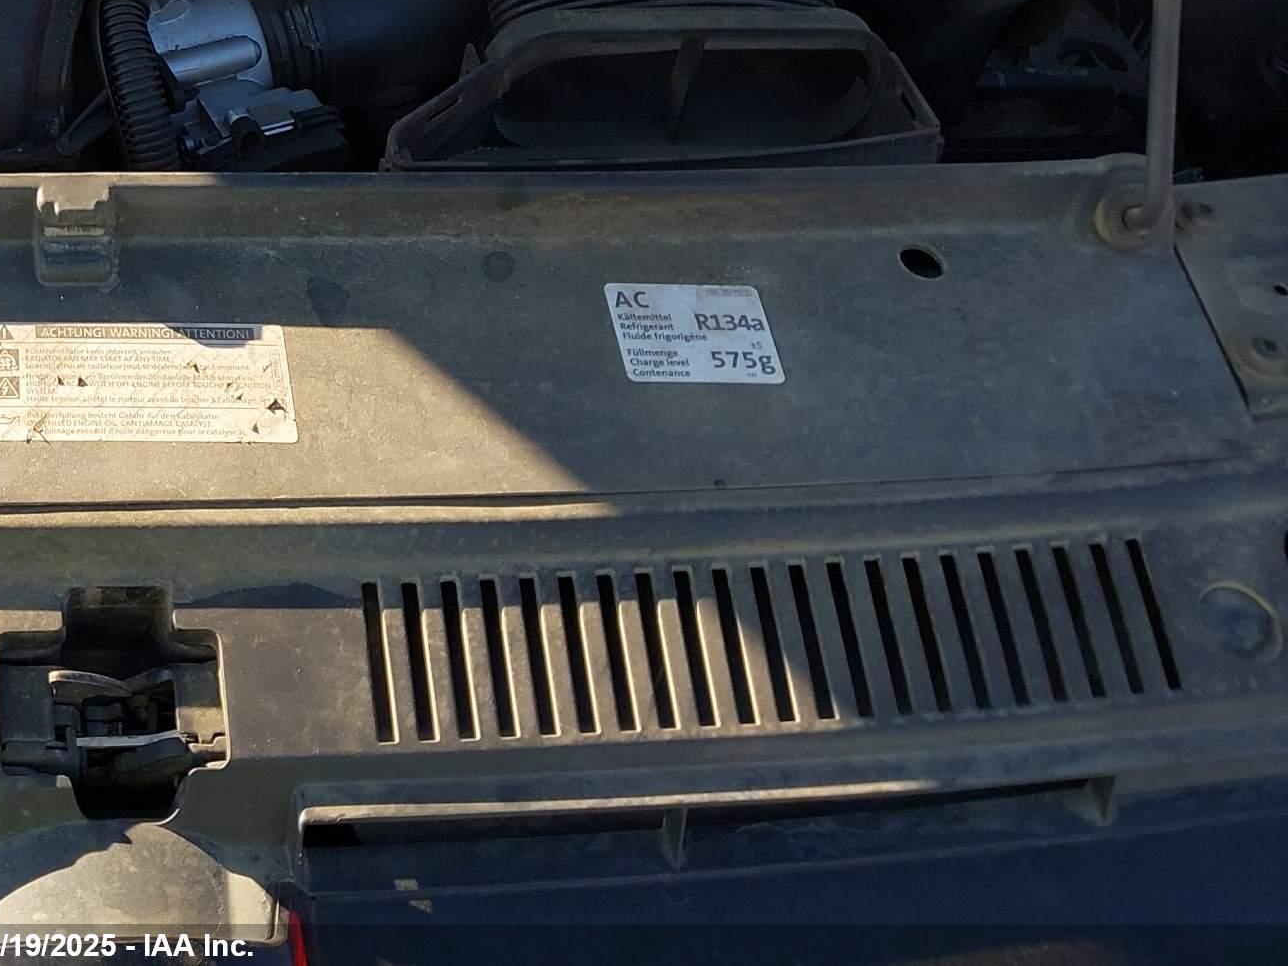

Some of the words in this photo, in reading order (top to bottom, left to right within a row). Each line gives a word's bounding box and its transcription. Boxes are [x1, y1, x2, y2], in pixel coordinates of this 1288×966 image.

[615, 290, 651, 309] AC
[620, 322, 675, 333] Refrigerant
[695, 313, 766, 332] R134a
[623, 332, 653, 341] Fluide
[627, 348, 679, 359] Füllmenge
[710, 350, 777, 376] 575g
[629, 358, 665, 369] Charge
[666, 358, 690, 367] level
[632, 368, 692, 378] Contenance
